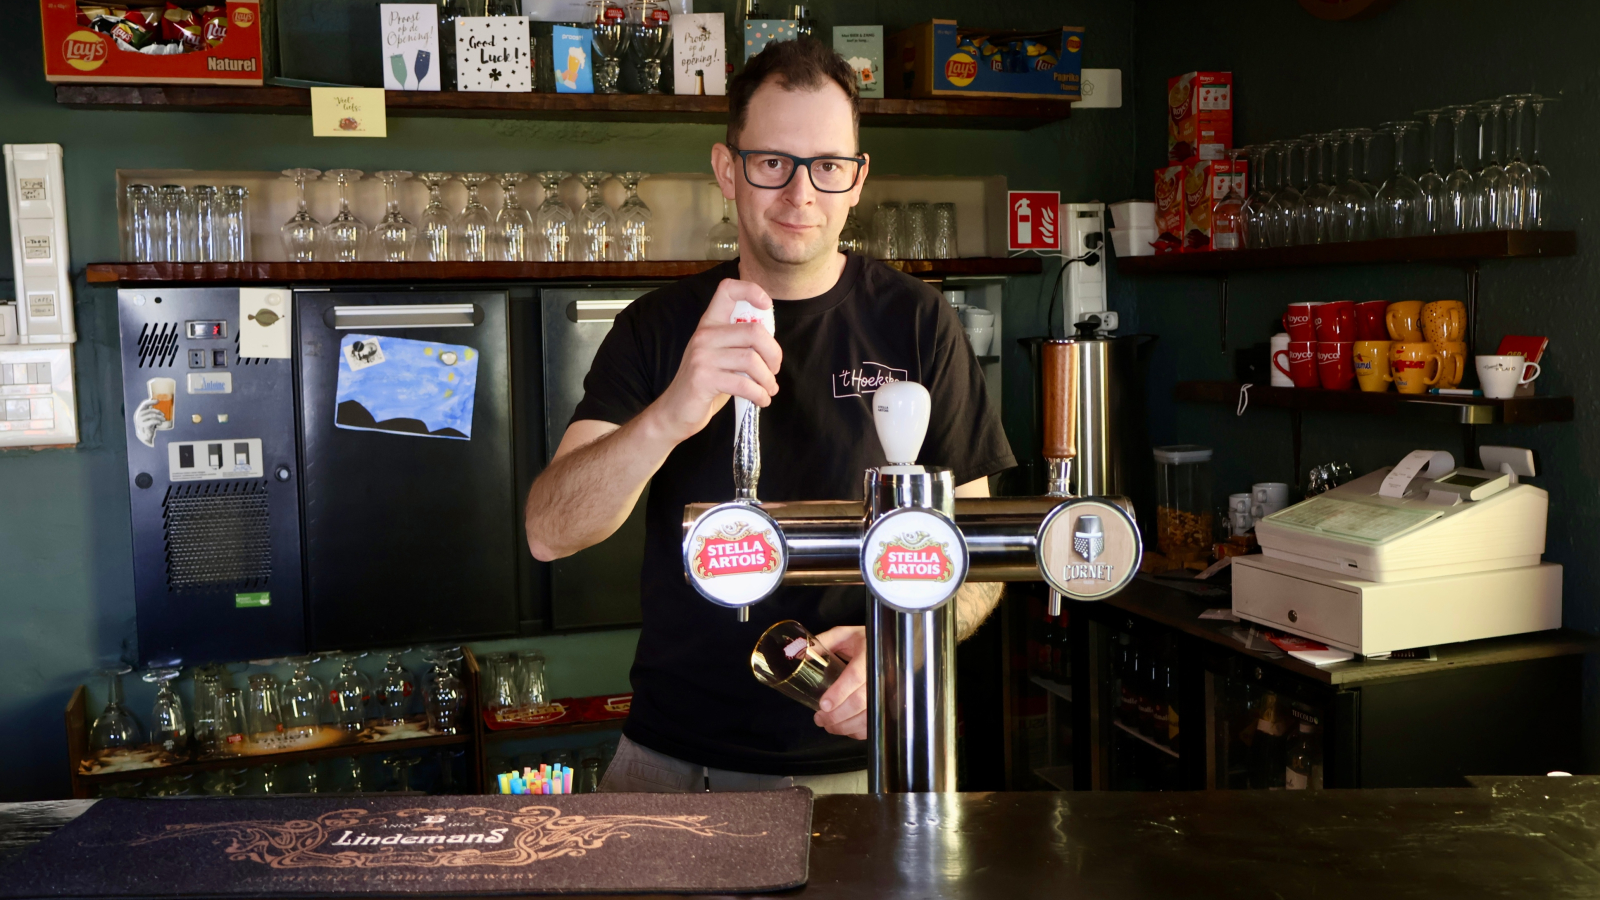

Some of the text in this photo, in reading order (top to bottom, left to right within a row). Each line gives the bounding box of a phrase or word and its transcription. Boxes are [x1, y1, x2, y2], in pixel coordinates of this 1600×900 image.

[389, 11, 419, 26] Proost
[398, 22, 418, 35] op de
[387, 26, 433, 48] Opening!
[469, 34, 497, 49] Good
[66, 40, 104, 62] Lay's
[207, 56, 257, 72] Naturel
[948, 59, 976, 78] Lay's
[707, 540, 764, 556] STELLA
[708, 553, 766, 569] ARTOIS
[888, 551, 940, 563] STELLA
[887, 563, 941, 575] ARTOIS
[1063, 564, 1114, 582] CORNET
